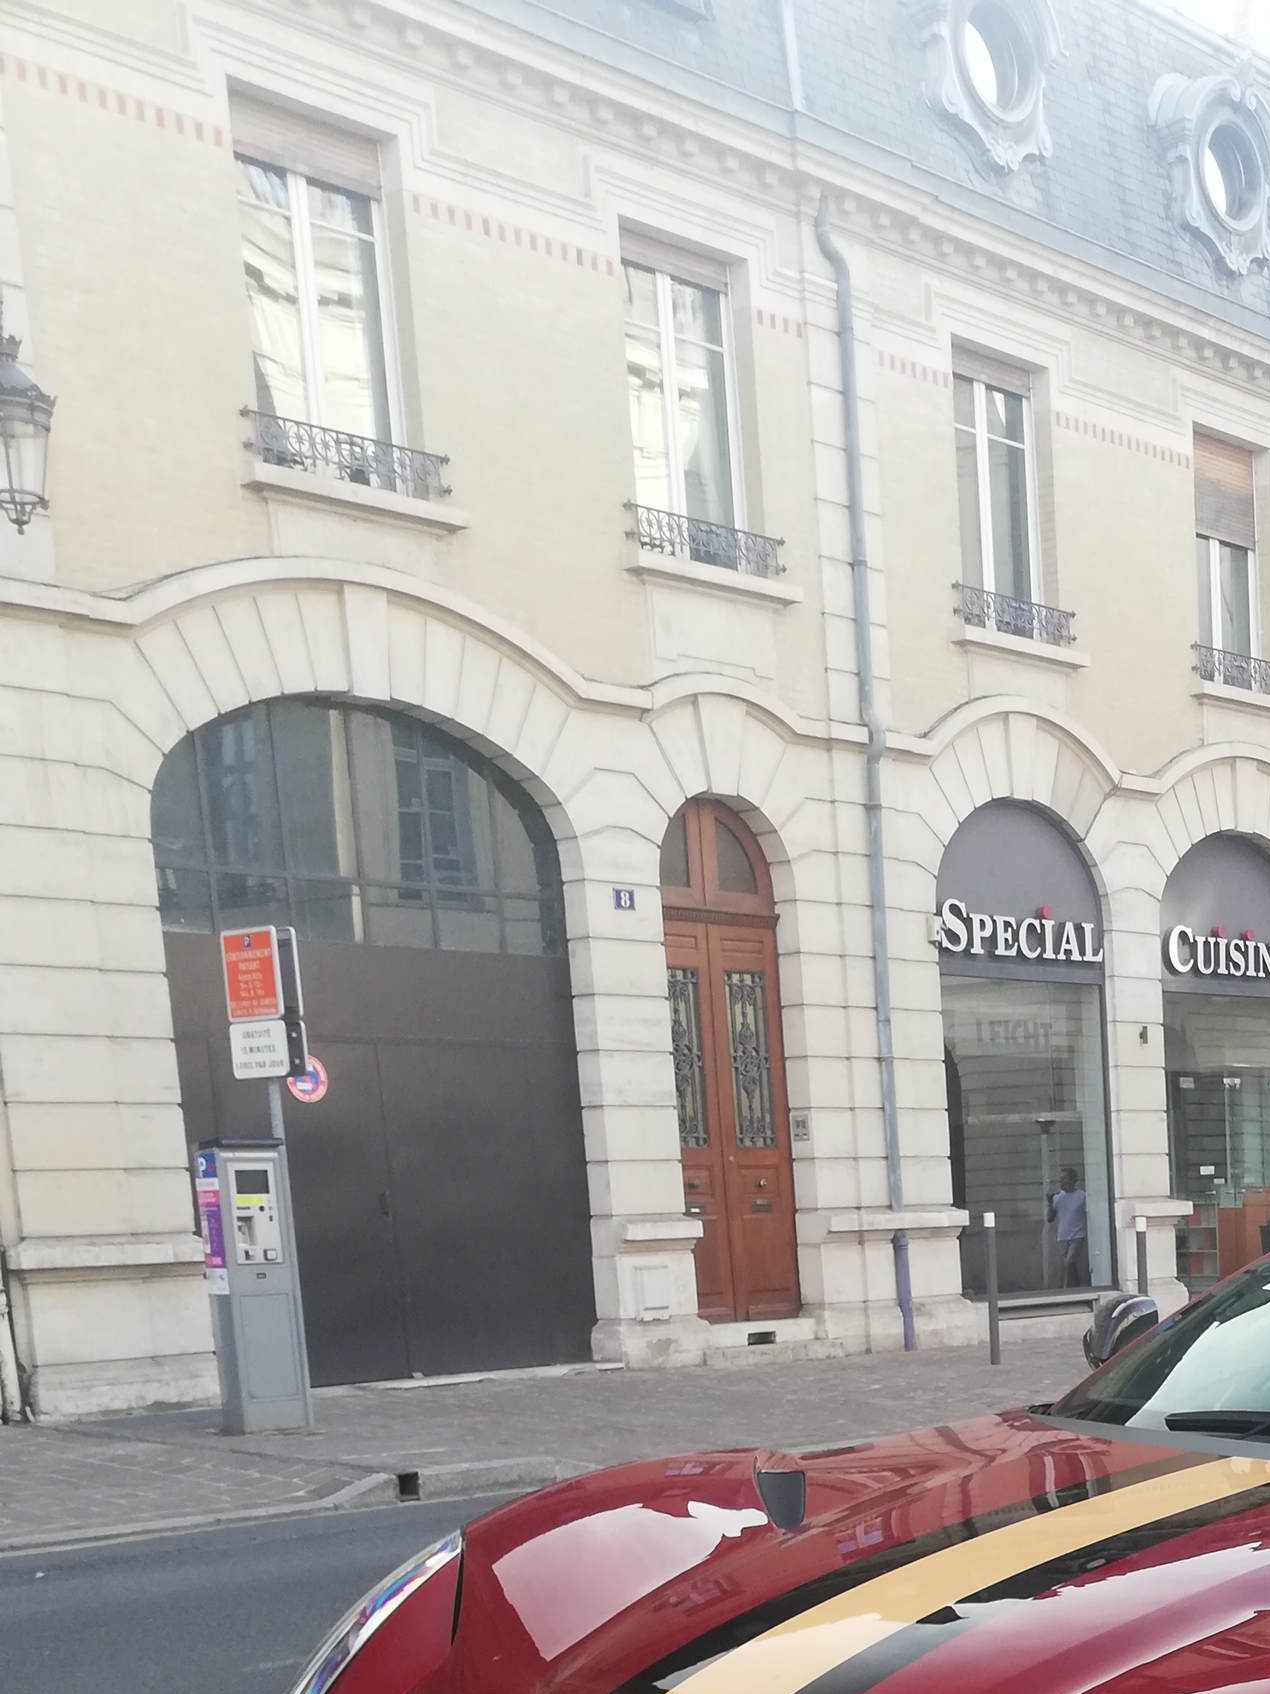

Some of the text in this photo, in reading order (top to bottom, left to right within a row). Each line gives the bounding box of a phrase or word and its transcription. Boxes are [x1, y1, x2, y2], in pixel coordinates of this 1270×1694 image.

[620, 891, 630, 908] 8
[940, 898, 1103, 963] SPECIAL
[249, 1044, 276, 1054] MINUTES
[255, 1060, 267, 1069] PAR
[268, 1058, 285, 1068] JOUR
